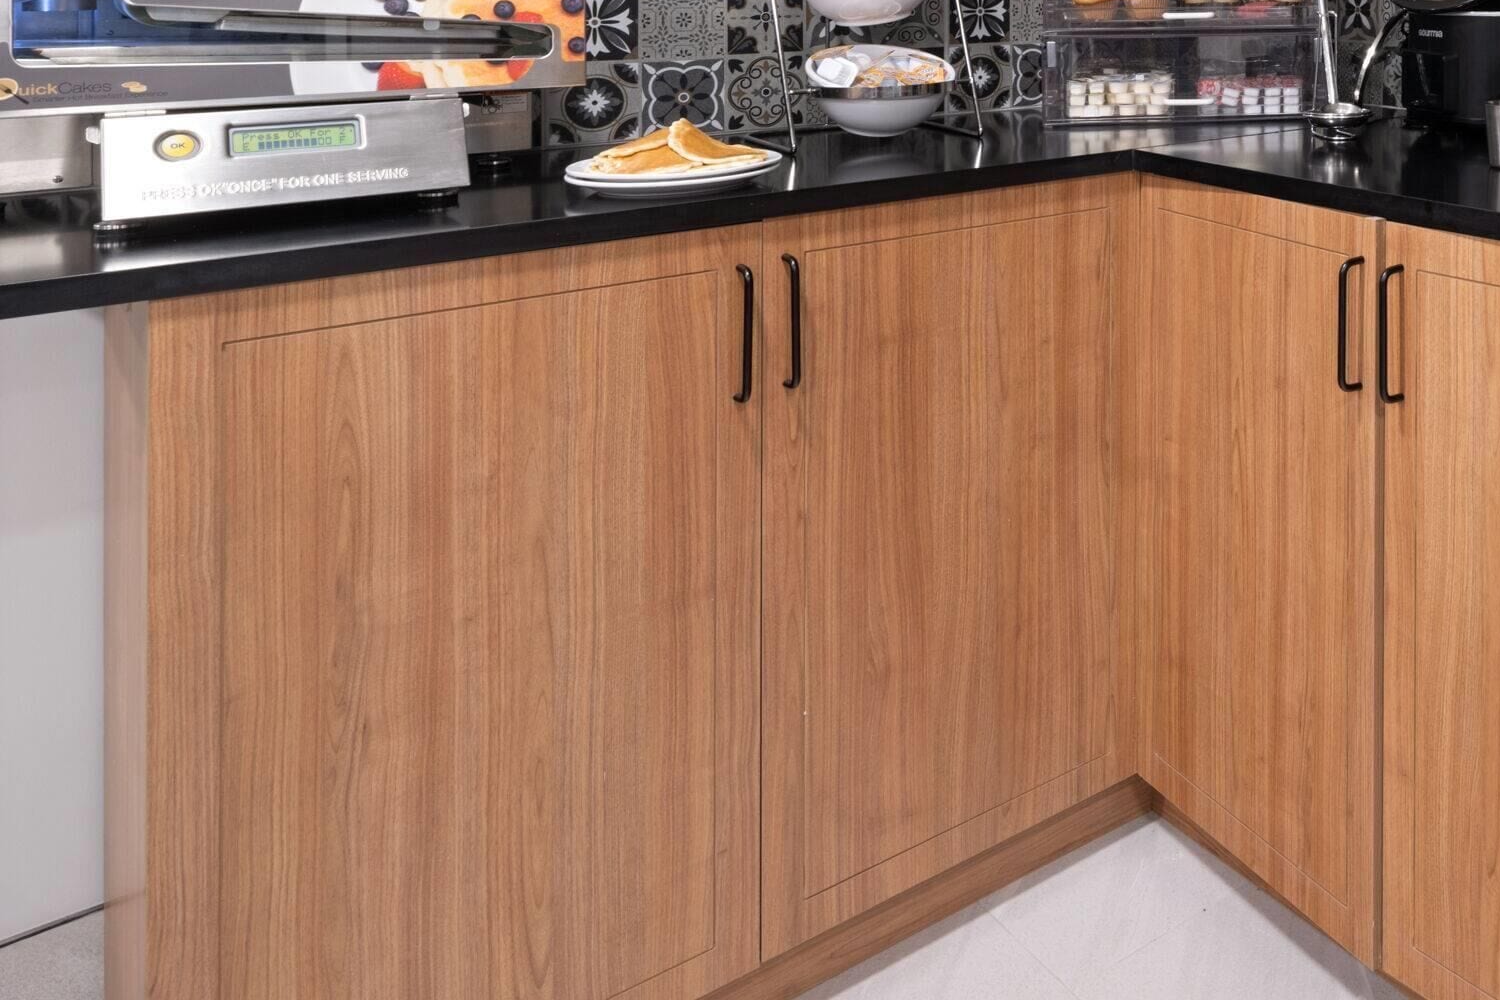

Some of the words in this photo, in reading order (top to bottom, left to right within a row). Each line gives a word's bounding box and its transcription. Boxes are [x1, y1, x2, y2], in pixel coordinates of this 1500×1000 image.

[242, 133, 280, 142] Press
[288, 130, 303, 139] OK
[310, 129, 332, 137] For
[141, 186, 197, 200] PRESS
[279, 175, 311, 190] FOR
[312, 172, 345, 187] ONE
[347, 167, 409, 183] SERVING
